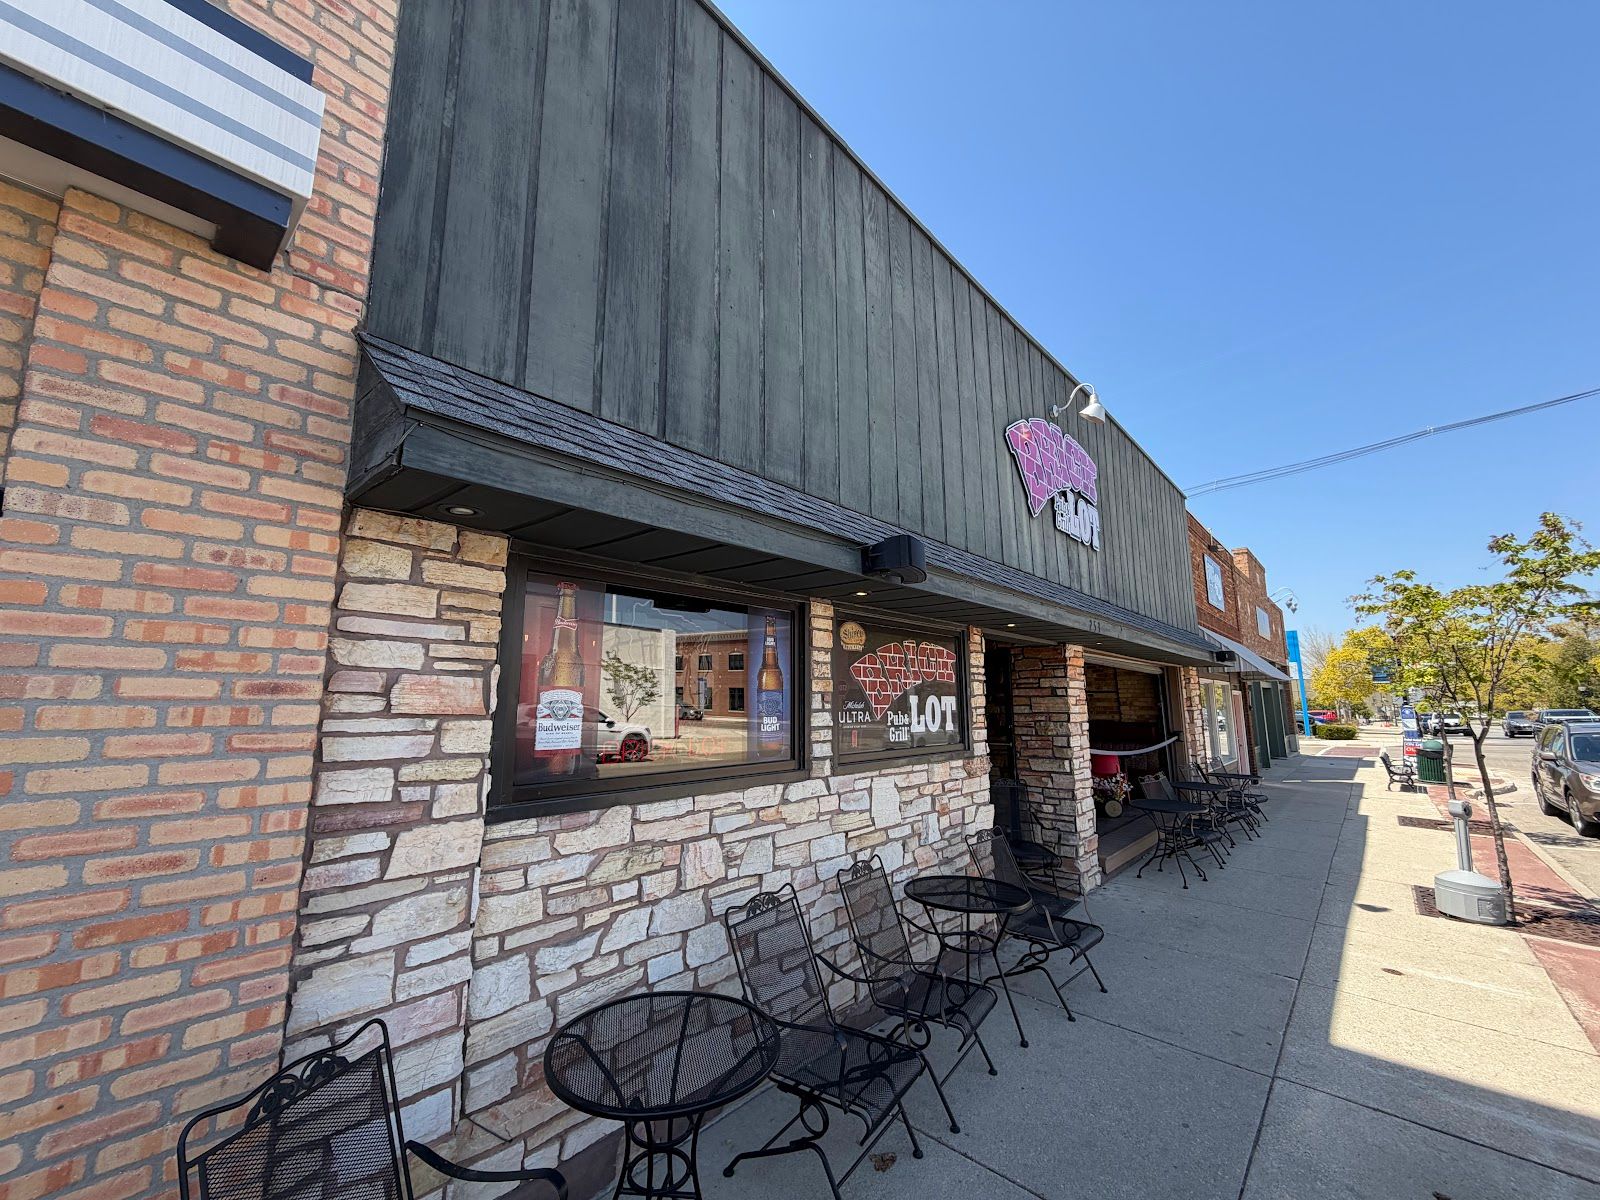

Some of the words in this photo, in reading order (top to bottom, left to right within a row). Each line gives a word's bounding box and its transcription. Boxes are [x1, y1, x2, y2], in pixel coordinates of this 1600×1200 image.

[1067, 489, 1100, 551] LOT
[850, 640, 956, 720] BRICK
[763, 716, 778, 724] BUD
[838, 711, 871, 723] ULTRA
[909, 695, 957, 733] LOT
[538, 722, 581, 732] Budweiser
[760, 723, 780, 732] LIGHT
[889, 726, 910, 742] Grill
